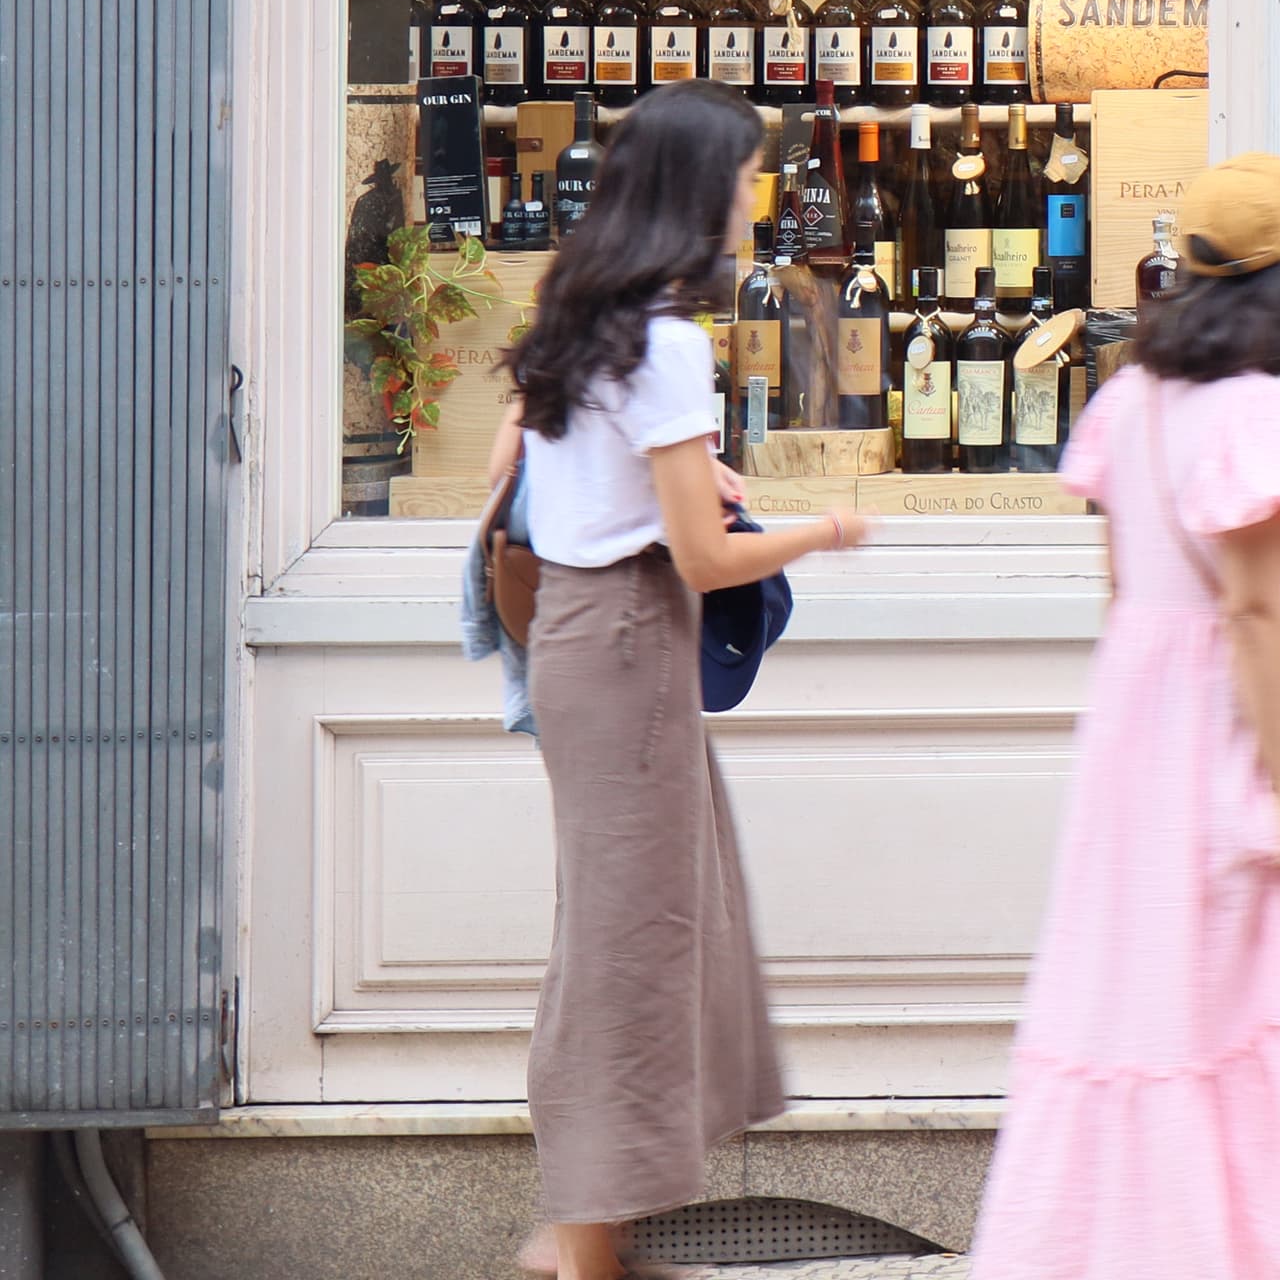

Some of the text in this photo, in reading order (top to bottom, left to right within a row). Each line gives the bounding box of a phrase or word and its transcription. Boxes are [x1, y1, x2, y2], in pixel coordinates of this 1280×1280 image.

[547, 49, 585, 57] SANDEMAN
[597, 49, 631, 57] SANDEMAN
[655, 49, 691, 57] SANDEMAN
[875, 49, 913, 58] SANDEMAN
[988, 49, 1025, 58] SANDEMAN
[423, 93, 472, 106] OUR GIN
[558, 180, 583, 192] OUR
[903, 492, 1043, 514] QUINTA DO CRASTO
